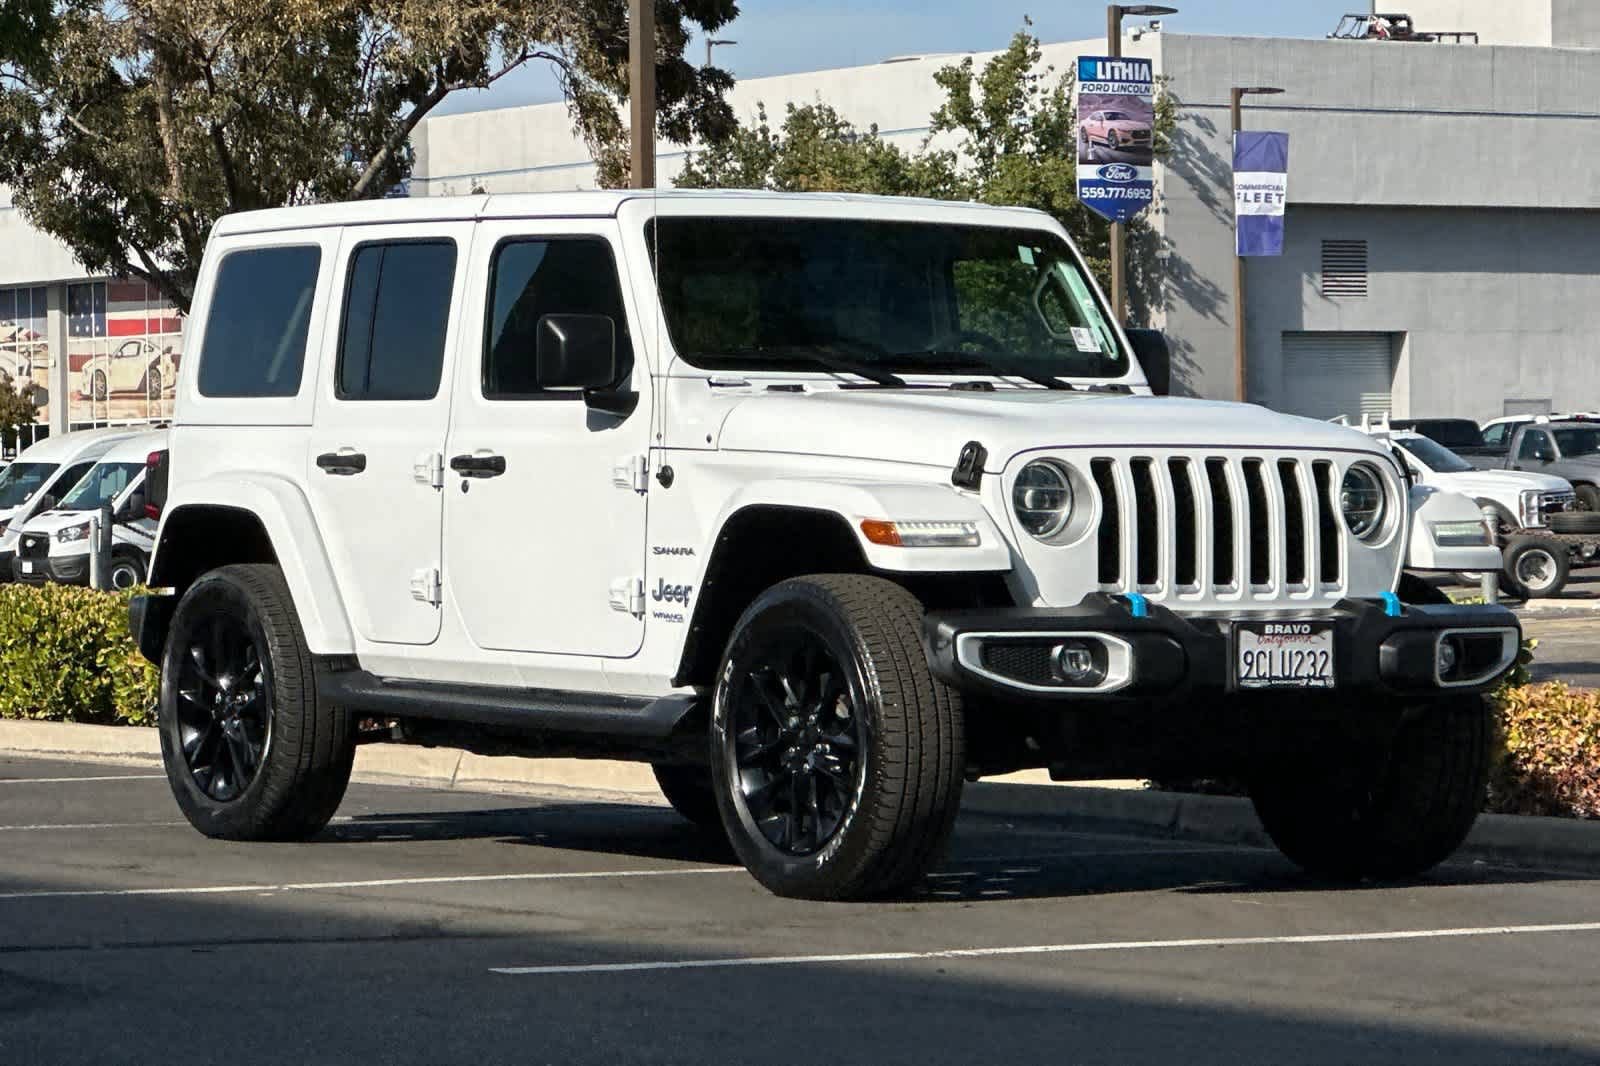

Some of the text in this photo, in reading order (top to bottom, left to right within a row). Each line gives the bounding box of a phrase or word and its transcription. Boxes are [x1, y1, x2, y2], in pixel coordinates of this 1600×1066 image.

[1096, 61, 1151, 81] LITHIA
[1081, 83, 1151, 94] FORD LINCOLN
[1105, 165, 1133, 180] Ford
[1081, 187, 1152, 200] 559.777.6952
[652, 546, 696, 556] SAHARA
[652, 577, 692, 608] Jeep
[1264, 624, 1312, 634] BRAVO
